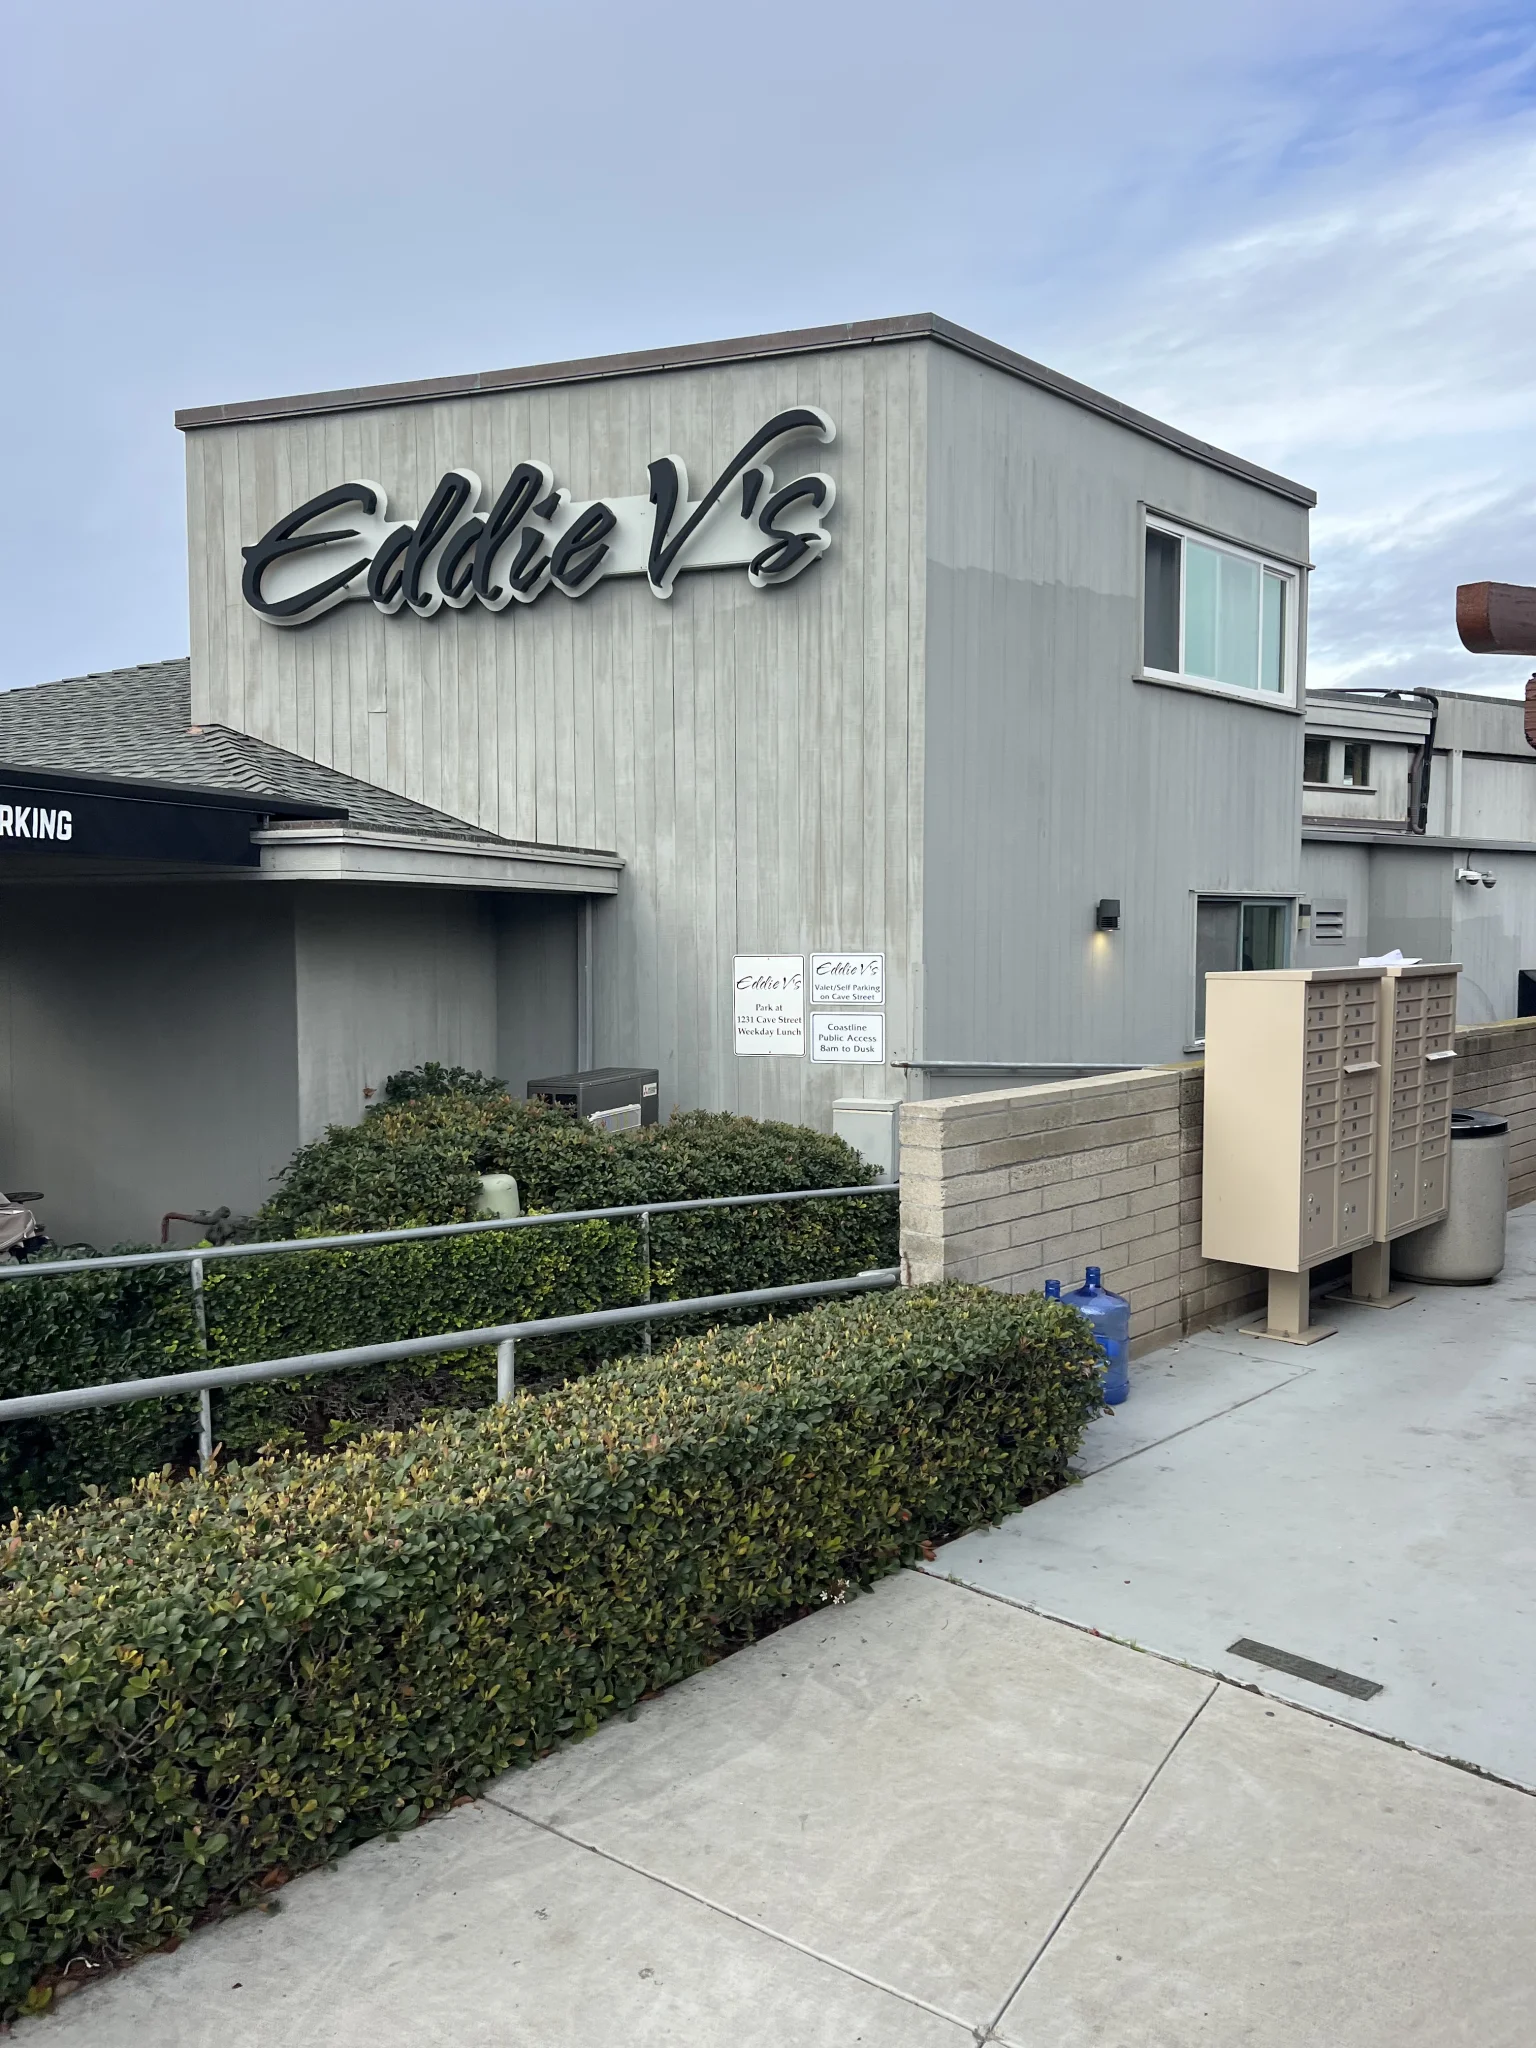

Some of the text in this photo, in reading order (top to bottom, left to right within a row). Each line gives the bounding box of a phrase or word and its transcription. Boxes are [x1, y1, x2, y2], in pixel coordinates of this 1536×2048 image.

[242, 409, 826, 617] Eddie V's
[0, 804, 72, 841] RKING
[816, 960, 879, 976] Eddie V's
[736, 973, 802, 991] Eddie V's
[814, 984, 881, 993] Valet/Self Parking
[819, 993, 830, 1001] on
[755, 1003, 783, 1012] Park at
[737, 1016, 802, 1024] 1231 Cave Street
[827, 1023, 867, 1031] Coastline
[738, 1028, 802, 1038] Weekday Lunch
[818, 1034, 877, 1043] Public Access
[819, 1044, 839, 1053] 8am
[853, 1045, 875, 1053] Dusk
